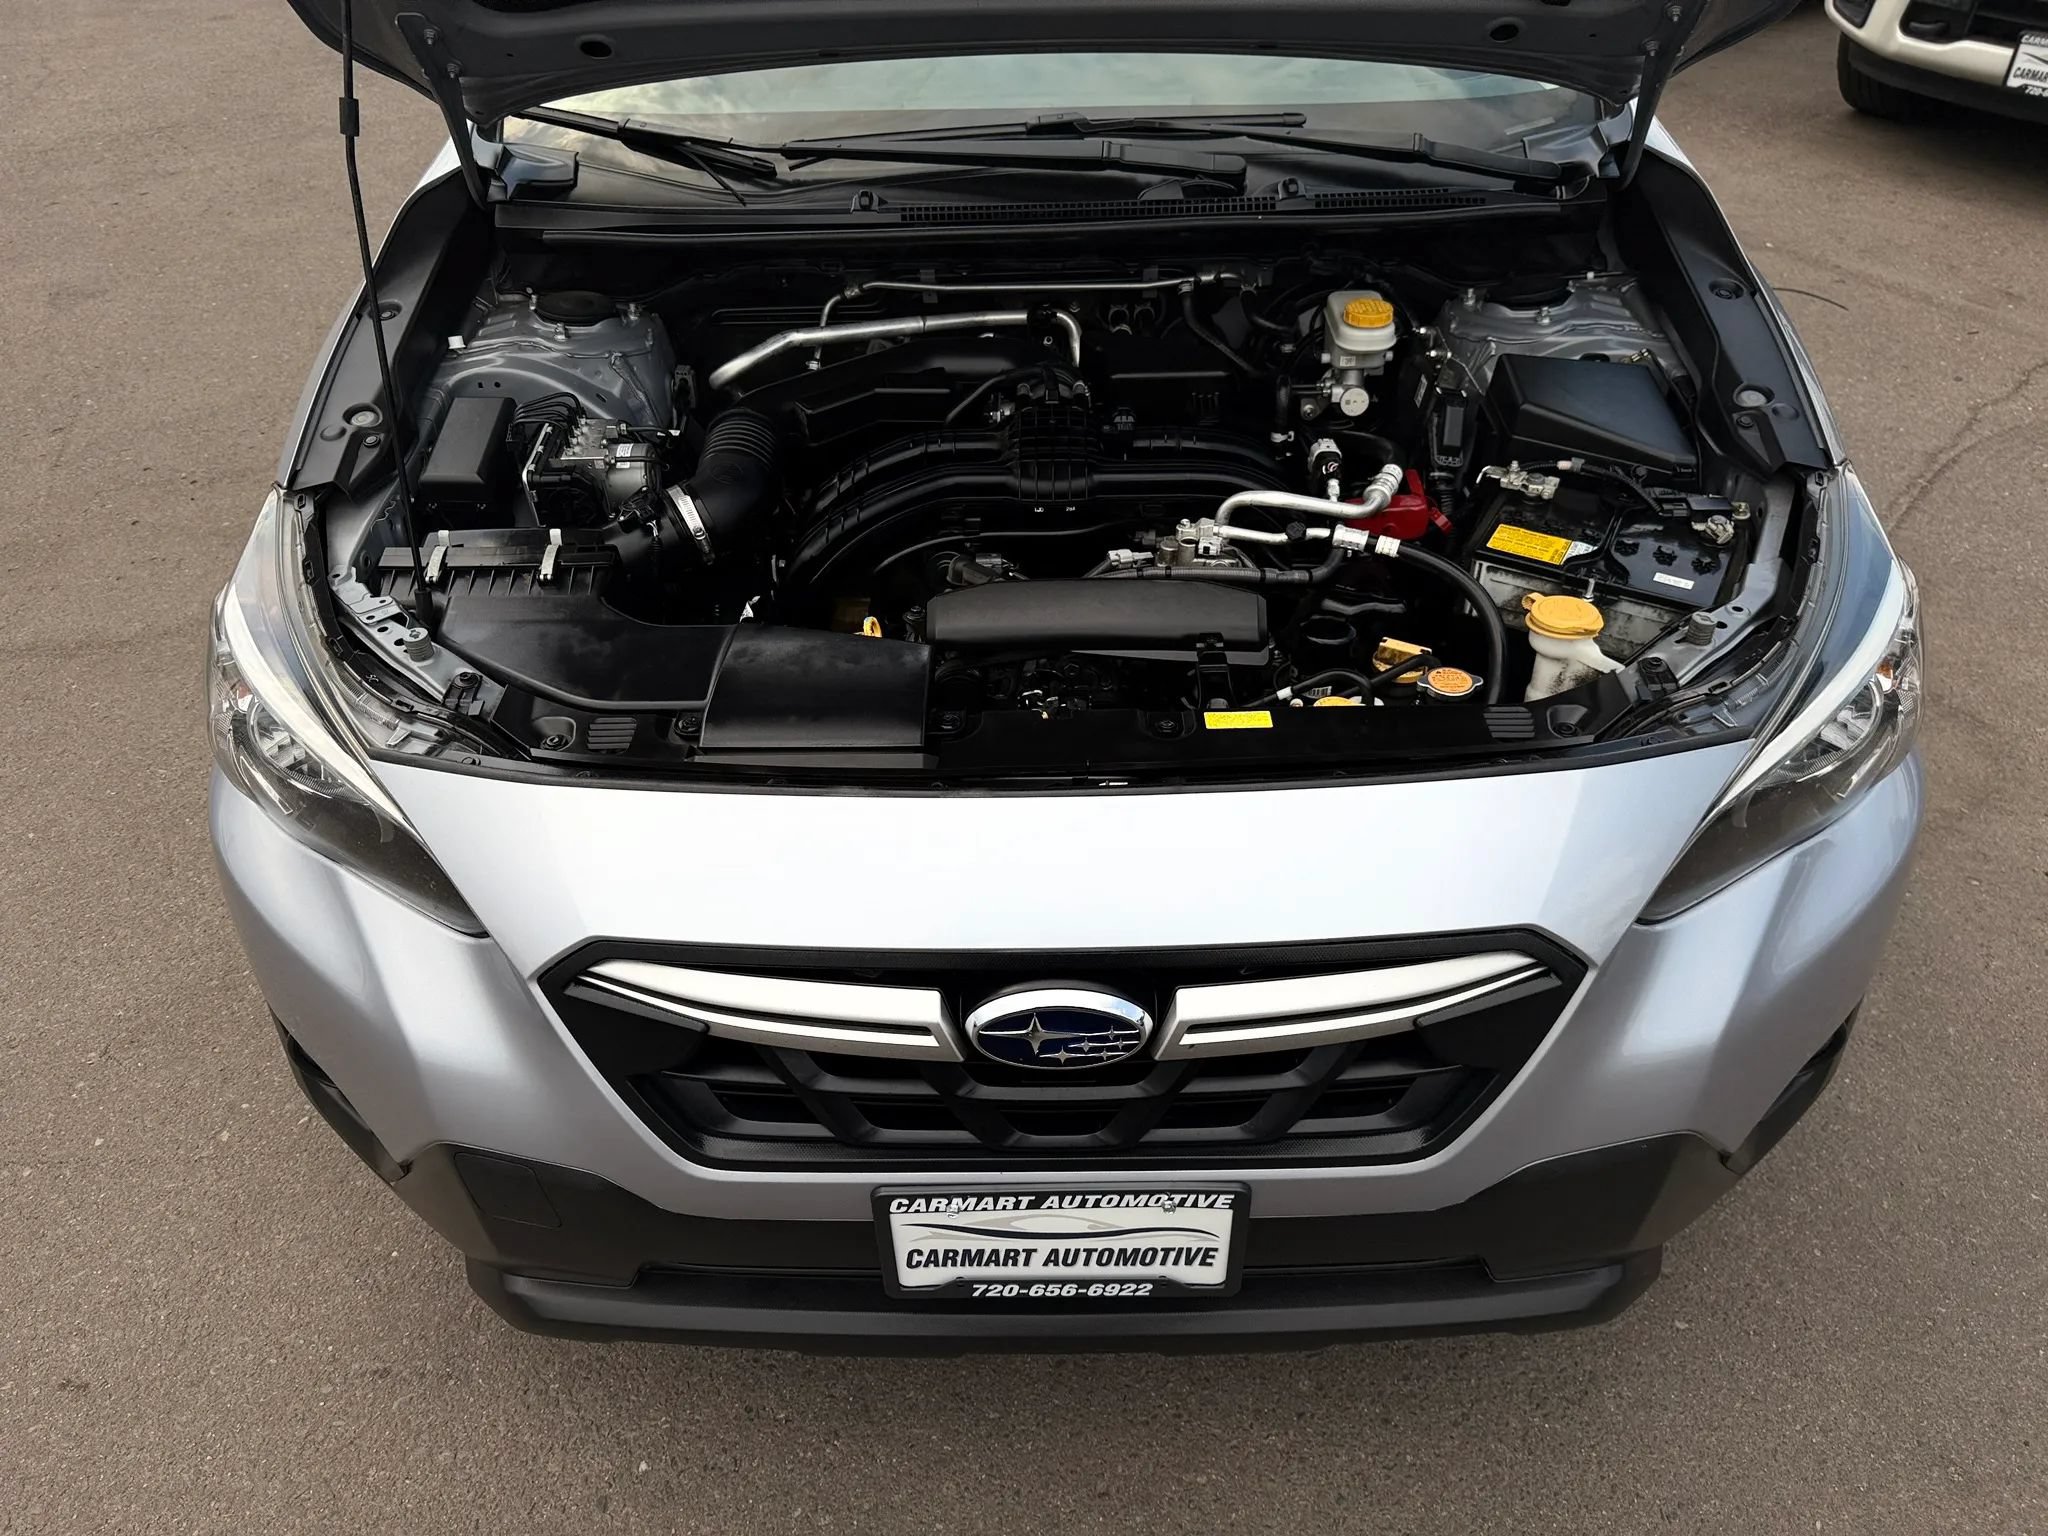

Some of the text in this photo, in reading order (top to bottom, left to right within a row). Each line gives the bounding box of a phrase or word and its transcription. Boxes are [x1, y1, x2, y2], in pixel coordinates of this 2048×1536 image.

[889, 1193, 1235, 1213] CARMART AUTOMOTIVE
[906, 1247, 1219, 1269] CARMART AUTOMOTIVE
[972, 1283, 1154, 1298] 720-656-6922
